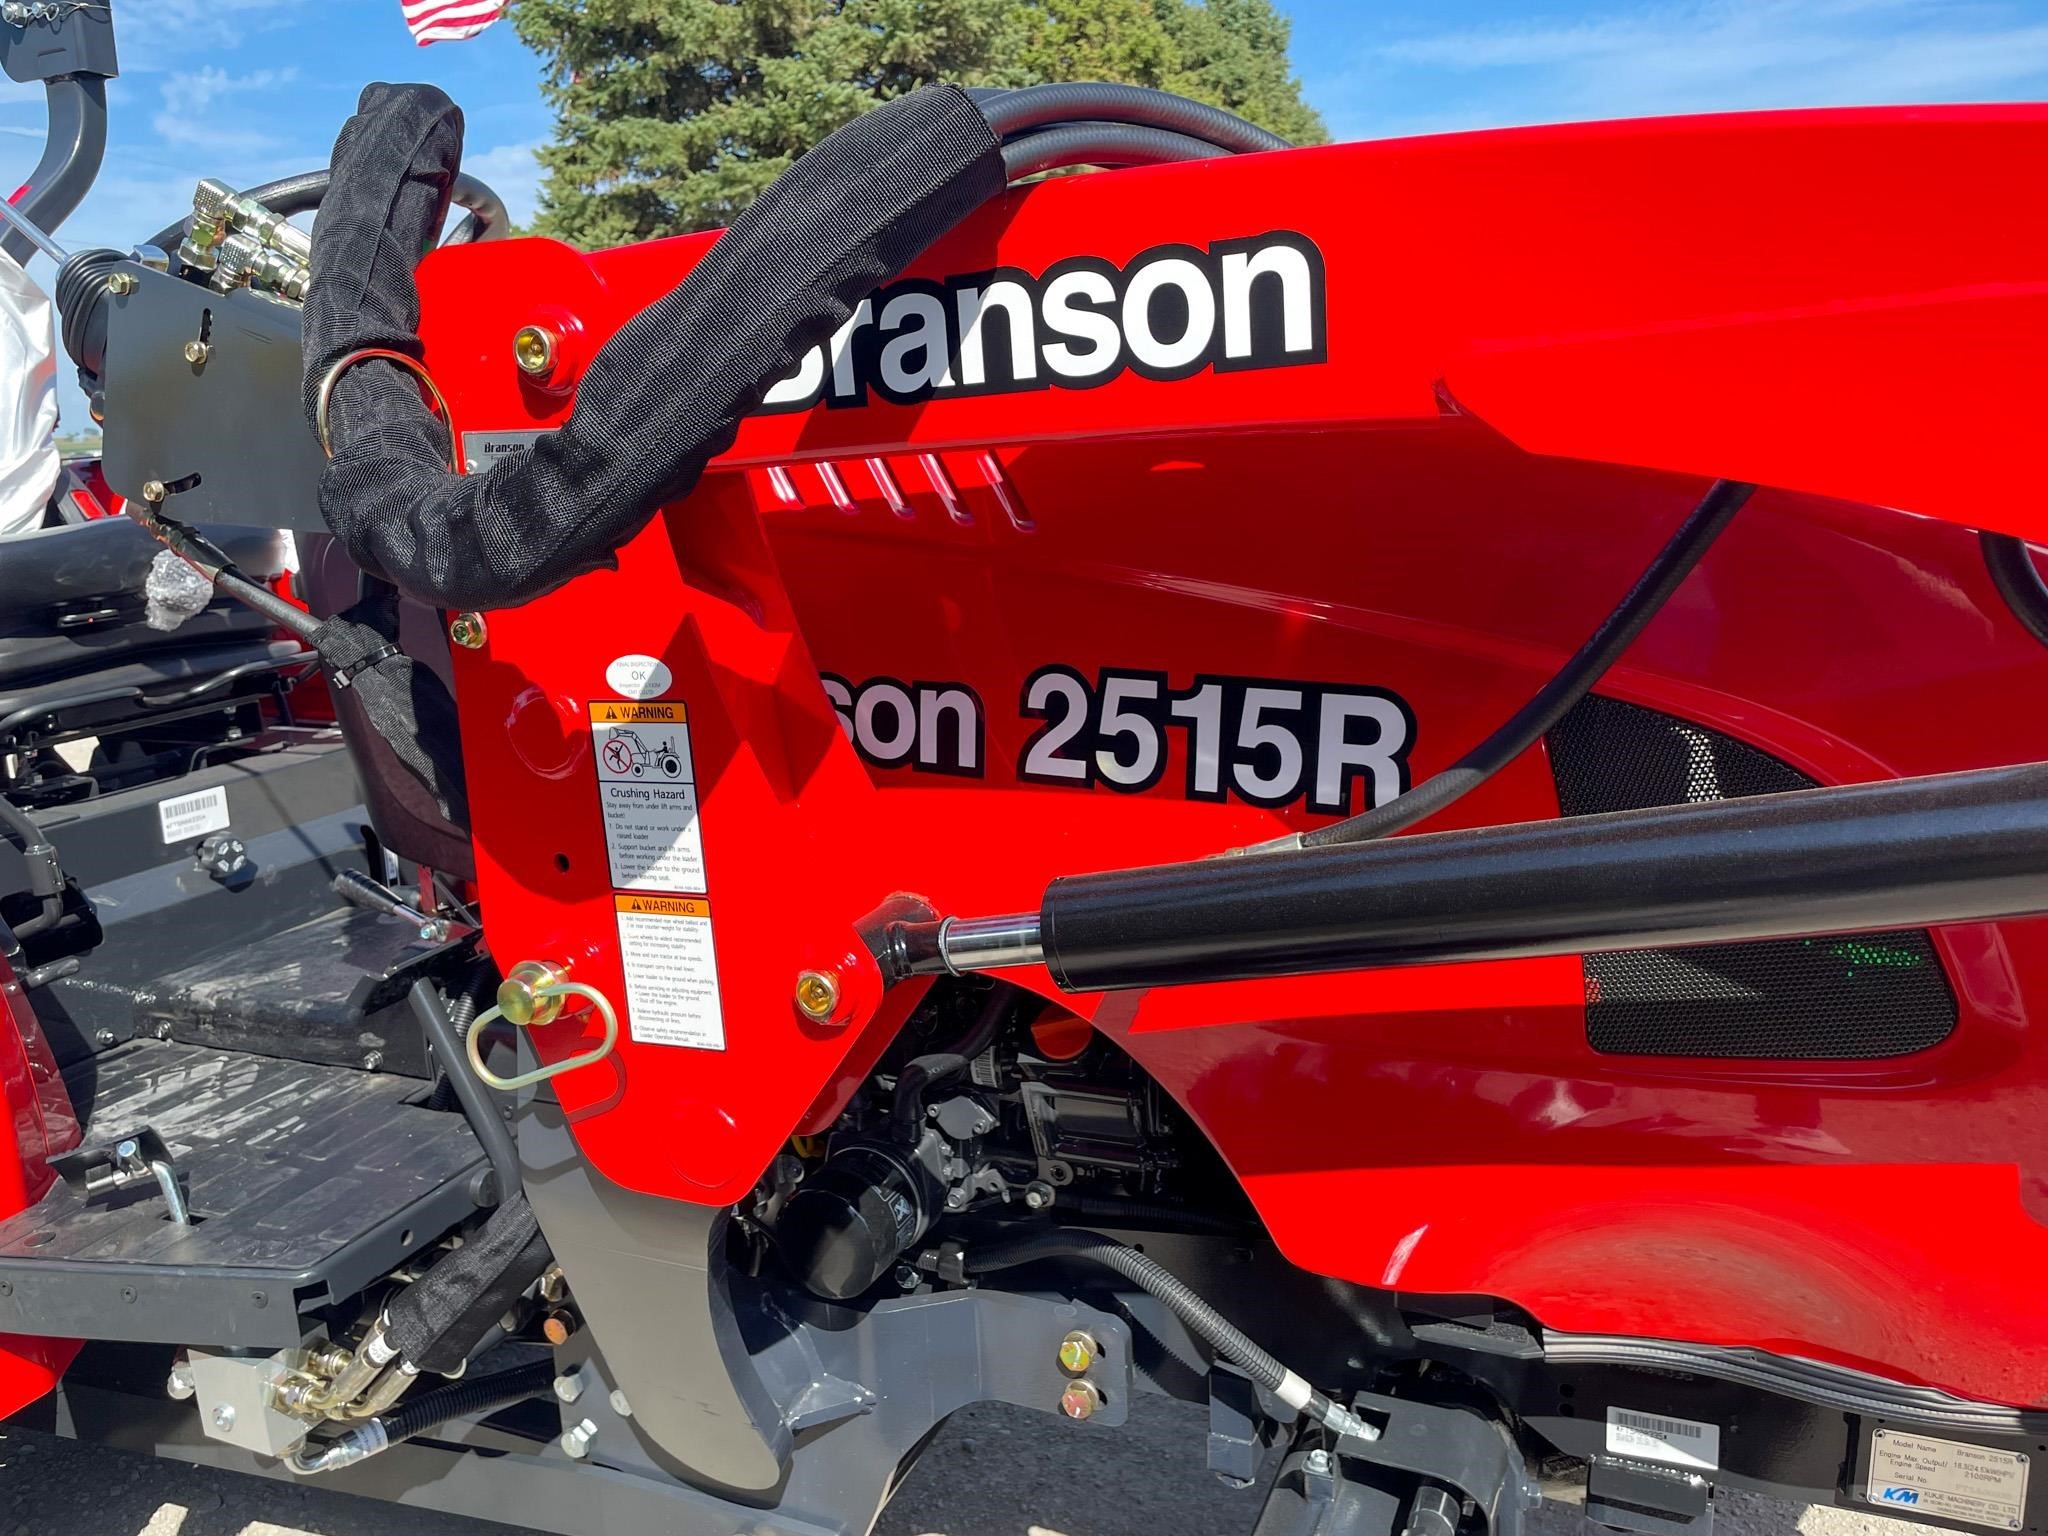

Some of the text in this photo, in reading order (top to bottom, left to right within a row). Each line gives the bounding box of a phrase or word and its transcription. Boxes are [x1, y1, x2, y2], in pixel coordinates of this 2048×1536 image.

[484, 442, 525, 453] Branson
[632, 671, 646, 680] OK
[620, 707, 674, 719] WARNING
[1025, 673, 1407, 808] 2515R
[611, 788, 685, 800] Crushing Hazard
[642, 900, 695, 913] WARNING
[638, 1015, 664, 1023] disconnecting
[1893, 1439, 2014, 1465] Model Name Branson 2515R
[1879, 1451, 1901, 1460] Engine
[1923, 1457, 1948, 1468] Output/
[1890, 1459, 2002, 1484] Engine Speed 2100RPM
[1894, 1472, 1914, 1481] Serial
[1883, 1488, 1919, 1504] KM
[1924, 1492, 1945, 1500] KUKJE
[1948, 1495, 1985, 1509] MACHINERY
